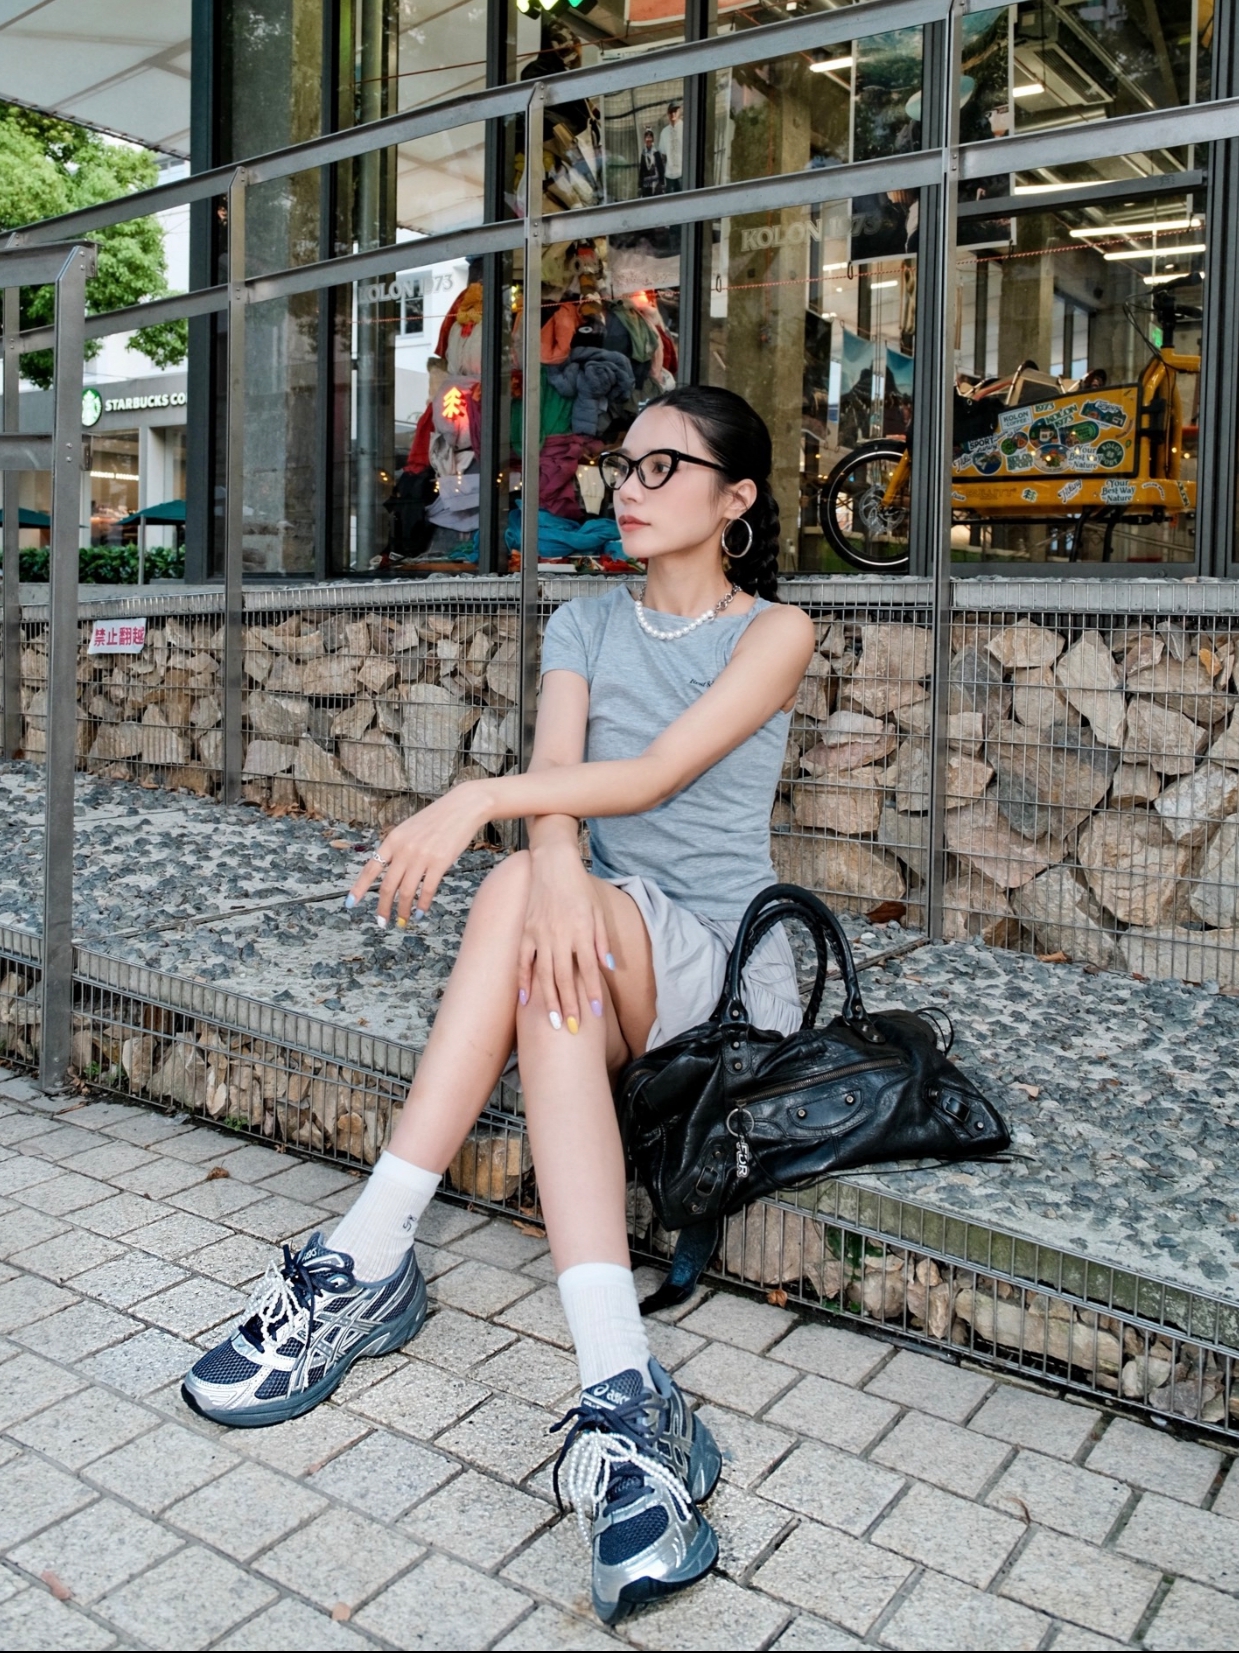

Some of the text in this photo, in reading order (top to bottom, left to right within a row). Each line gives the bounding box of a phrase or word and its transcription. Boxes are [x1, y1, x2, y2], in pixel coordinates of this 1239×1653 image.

[741, 218, 822, 251] KOLON
[105, 392, 187, 412] STARBUCKS CO
[1003, 411, 1028, 422] KOLON
[969, 437, 994, 449] SPORT
[1106, 479, 1129, 488] Your
[1102, 486, 1135, 496] Best Way
[1105, 495, 1132, 504] Nature
[94, 626, 144, 647] 禁止翻越
